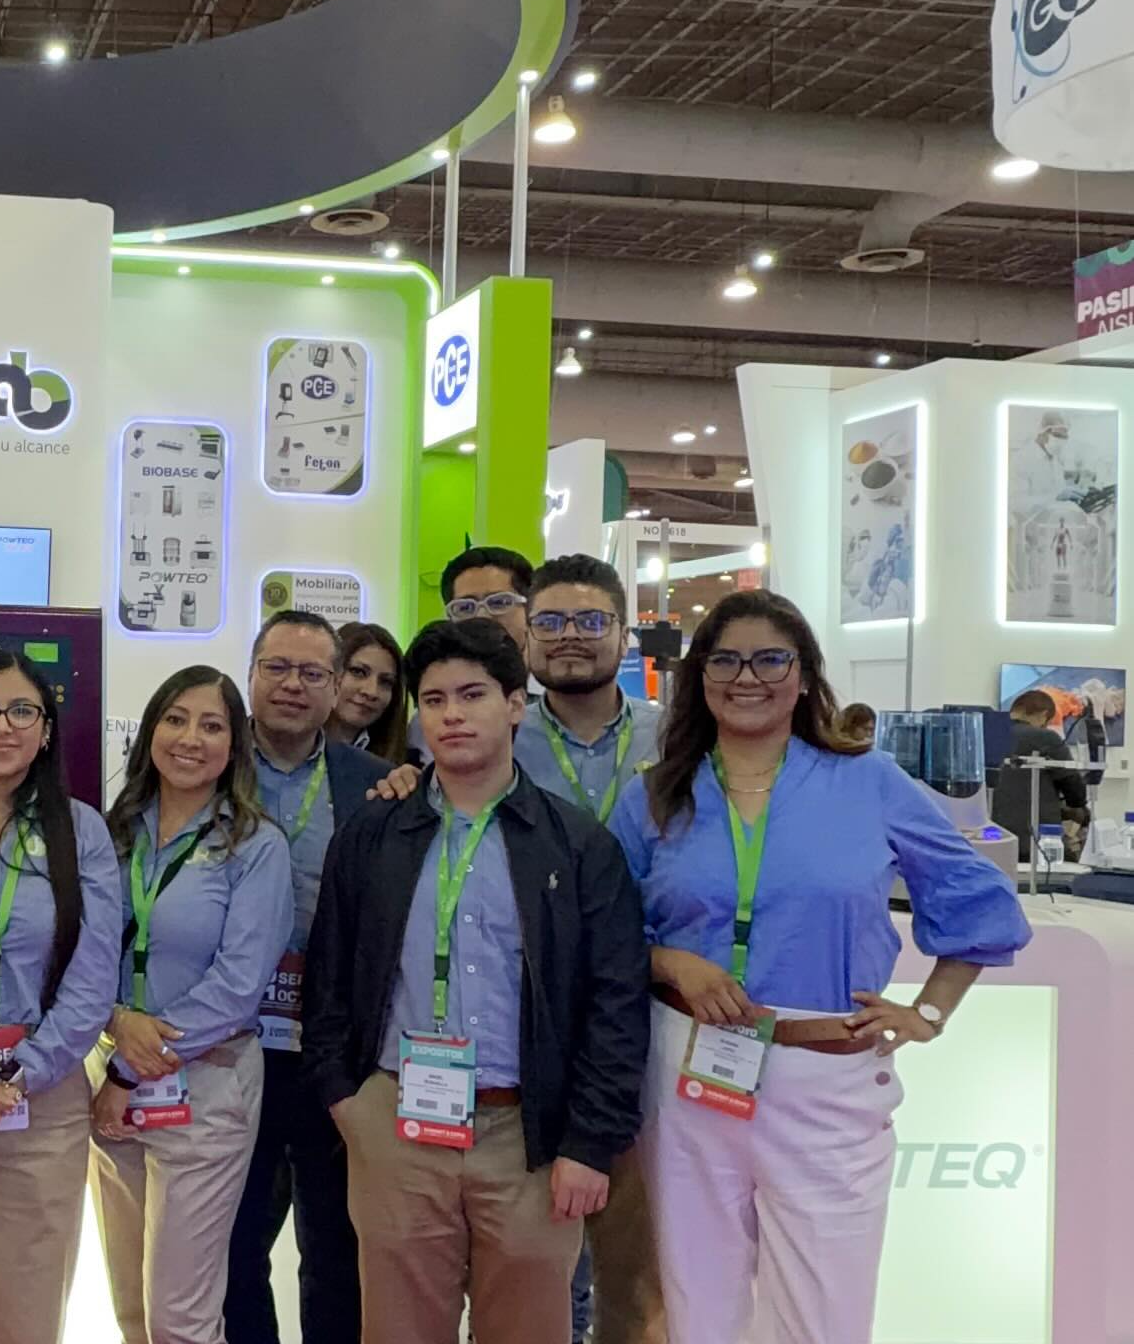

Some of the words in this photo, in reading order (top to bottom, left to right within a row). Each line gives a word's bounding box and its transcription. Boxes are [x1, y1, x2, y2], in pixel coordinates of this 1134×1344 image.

[434, 343, 468, 399] PCE
[303, 377, 334, 397] PCE
[15, 440, 71, 455] alcance
[142, 466, 199, 478] BIOBASE
[296, 578, 360, 592] Mobiliario
[295, 600, 360, 615] laboratorio
[893, 1142, 1026, 1189] TEQ
